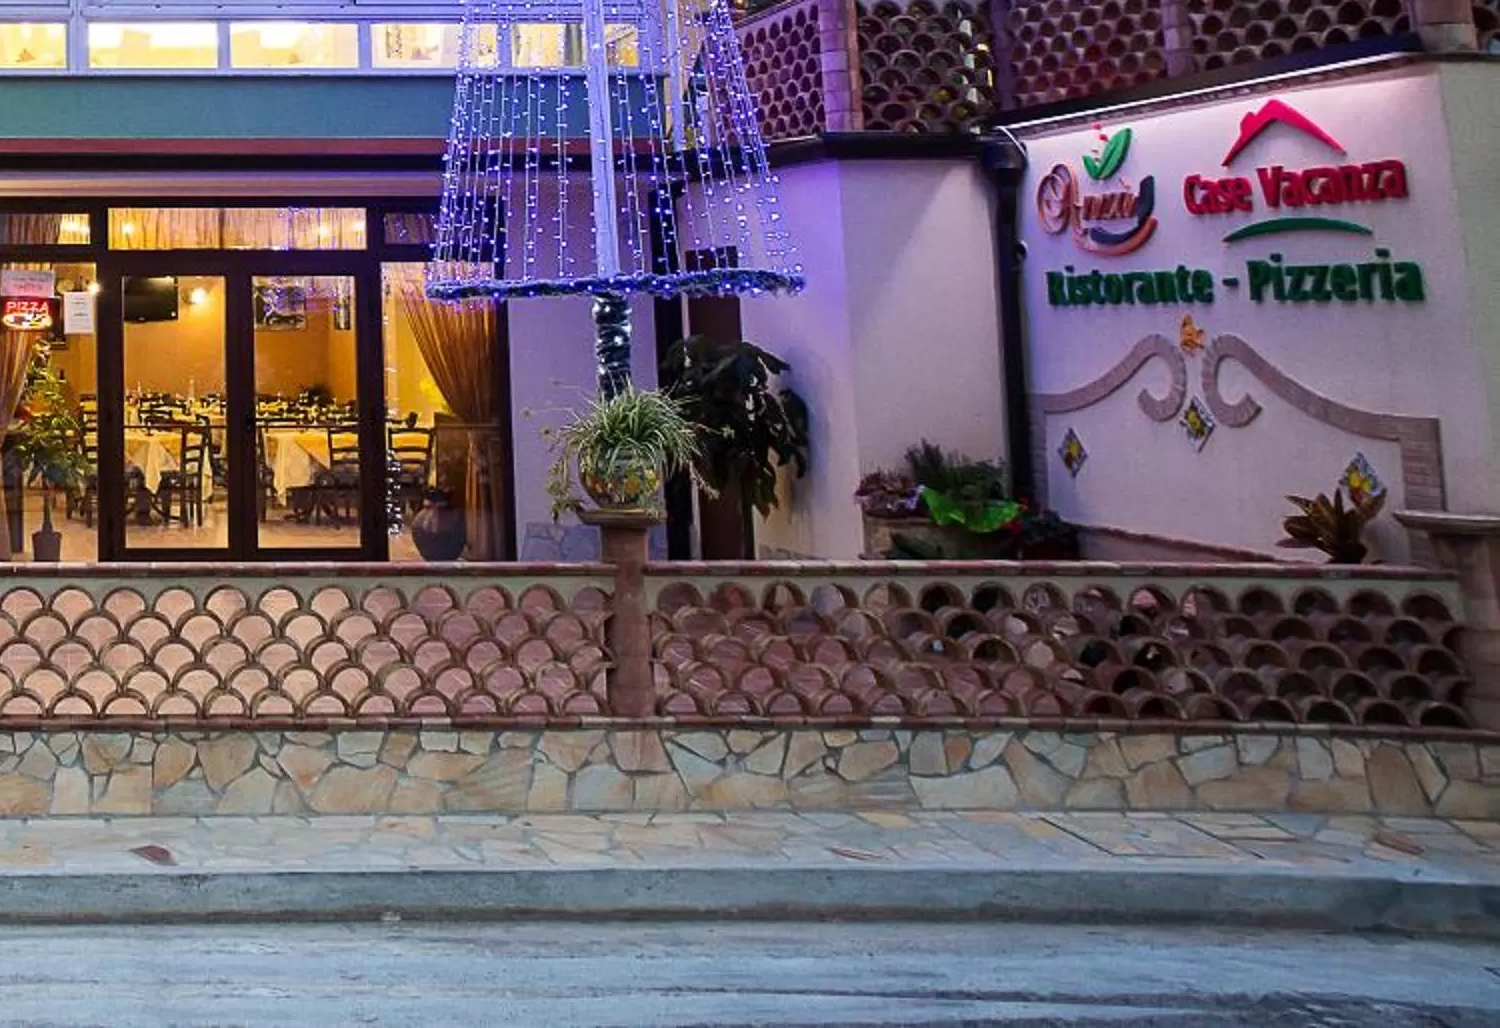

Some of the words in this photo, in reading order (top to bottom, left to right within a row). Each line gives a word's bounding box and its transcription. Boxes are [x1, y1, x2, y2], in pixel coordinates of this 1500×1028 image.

[1183, 173, 1253, 215] Case
[1257, 160, 1409, 208] Vacanza
[1046, 264, 1215, 306] Ristorante
[1246, 247, 1426, 302] Pizzeria
[6, 301, 49, 314] PIZZA
